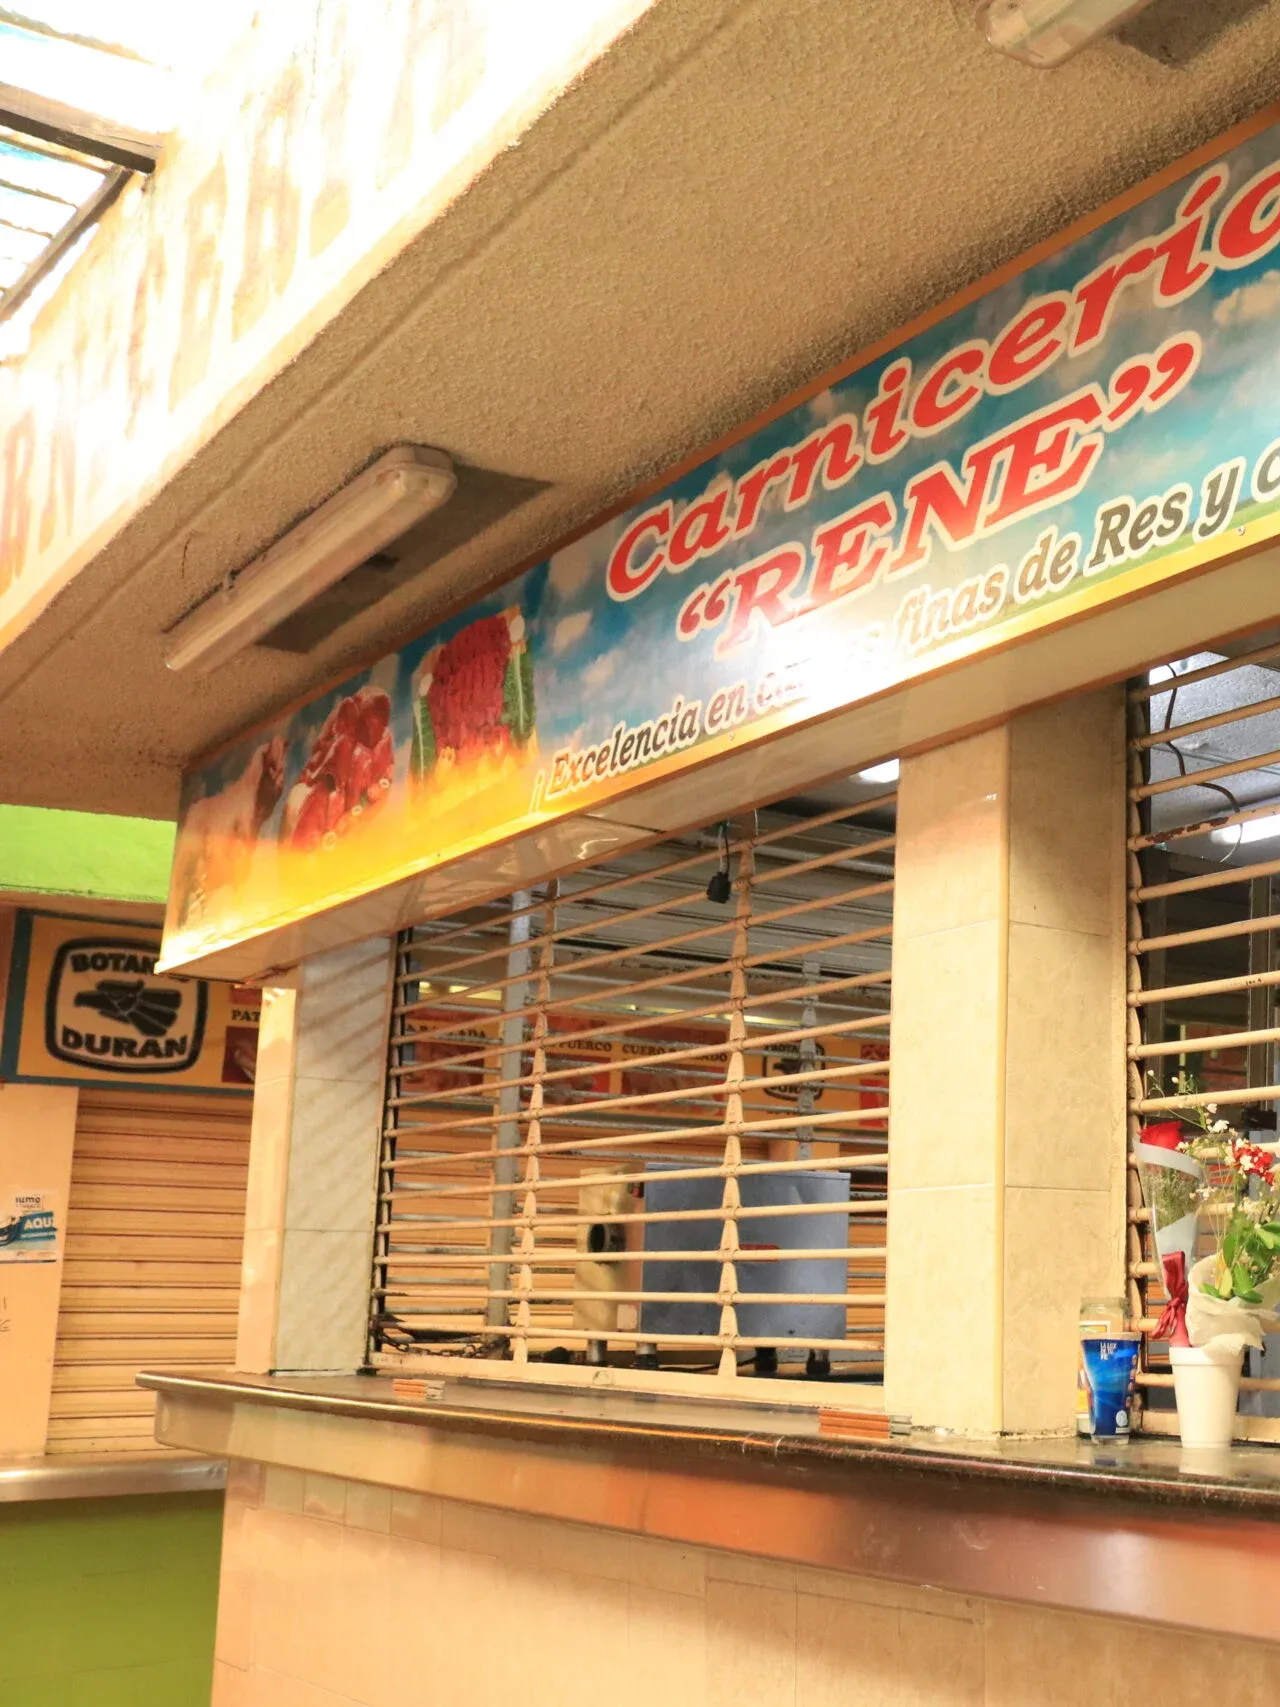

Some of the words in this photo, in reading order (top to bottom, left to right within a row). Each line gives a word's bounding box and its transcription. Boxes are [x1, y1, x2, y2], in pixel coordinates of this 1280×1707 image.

[706, 684, 747, 729] en
[899, 571, 1007, 648] finas
[1018, 534, 1077, 597] de
[1088, 490, 1189, 569] Res
[1197, 462, 1240, 539] y
[72, 952, 168, 976] BOTAN
[61, 1025, 188, 1058] DURAN
